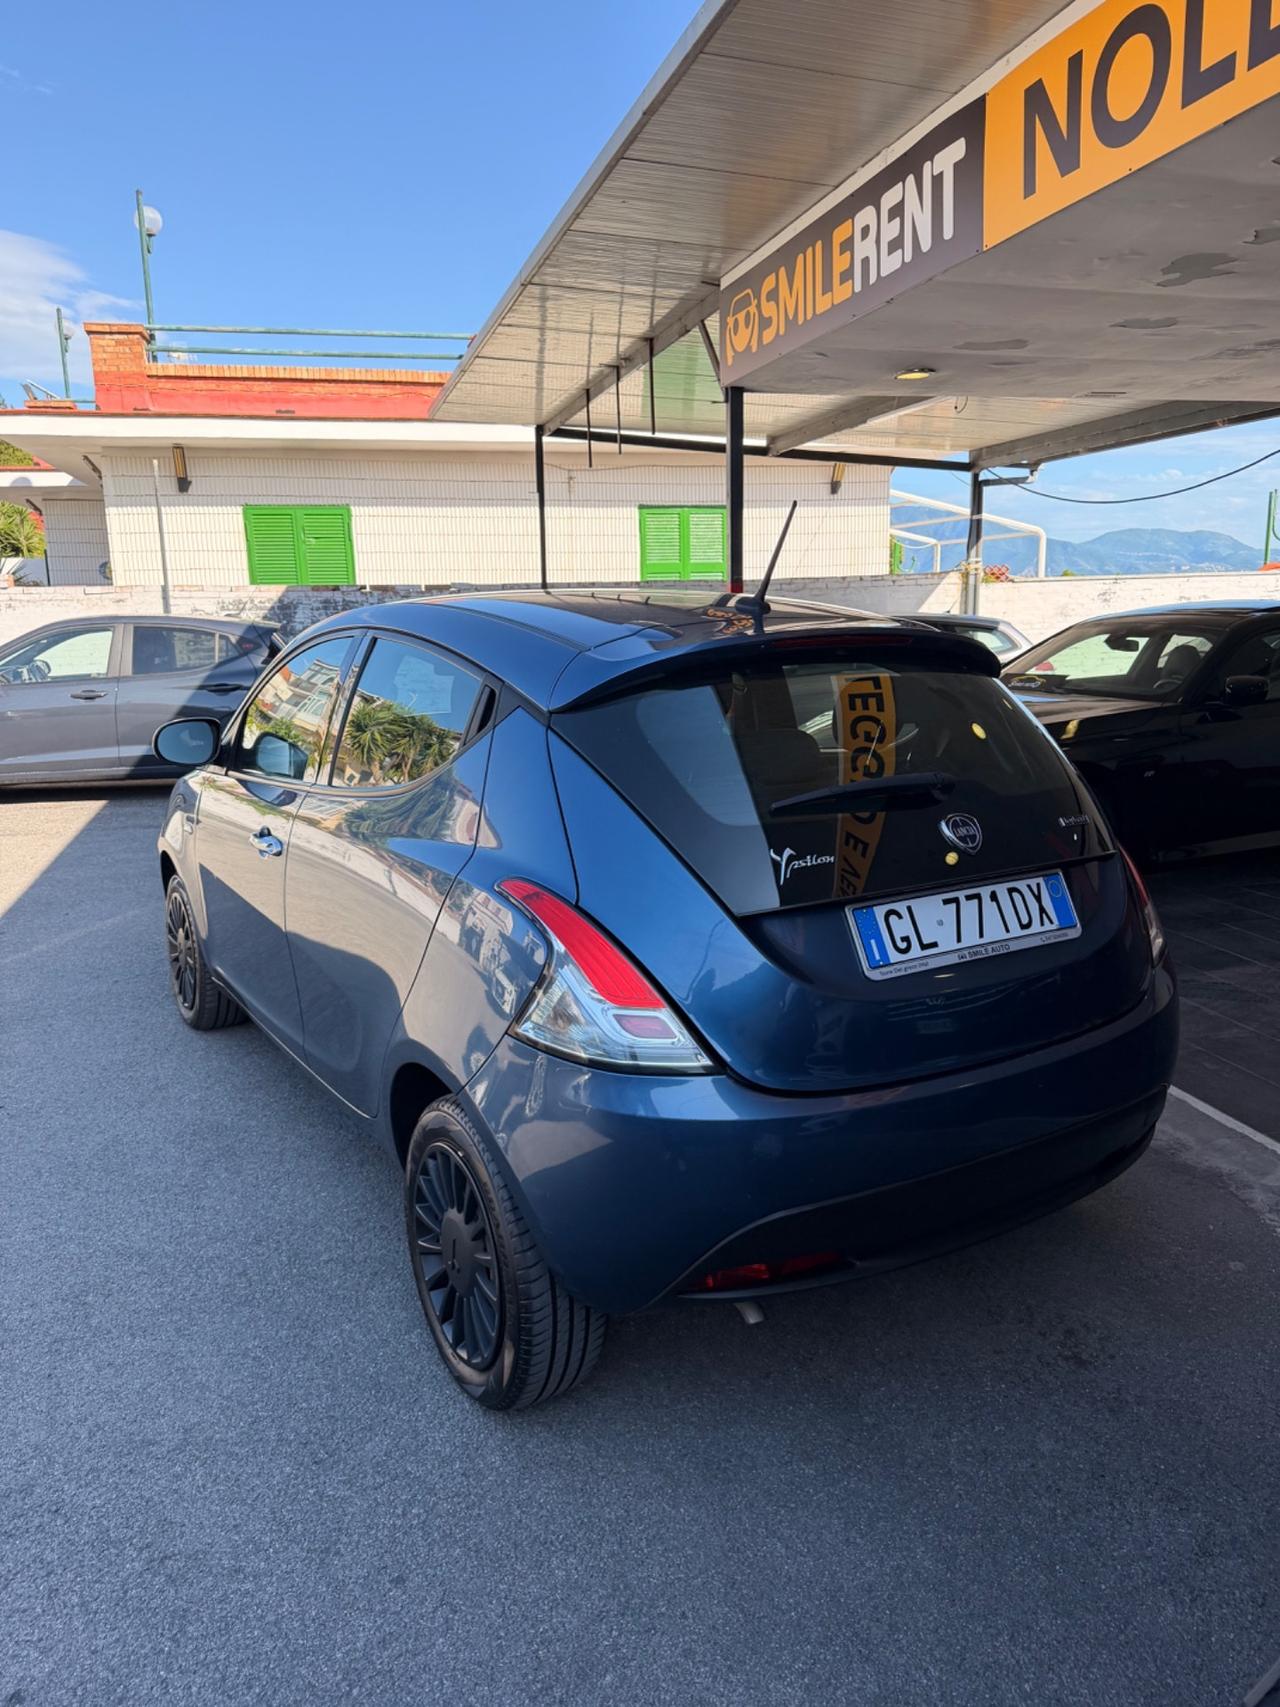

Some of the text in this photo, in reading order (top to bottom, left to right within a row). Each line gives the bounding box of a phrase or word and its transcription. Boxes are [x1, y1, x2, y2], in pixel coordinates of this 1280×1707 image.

[761, 137, 966, 344] SMILERENT
[770, 847, 835, 886] Ypsilon
[967, 943, 1011, 960] SMILE AUTO
